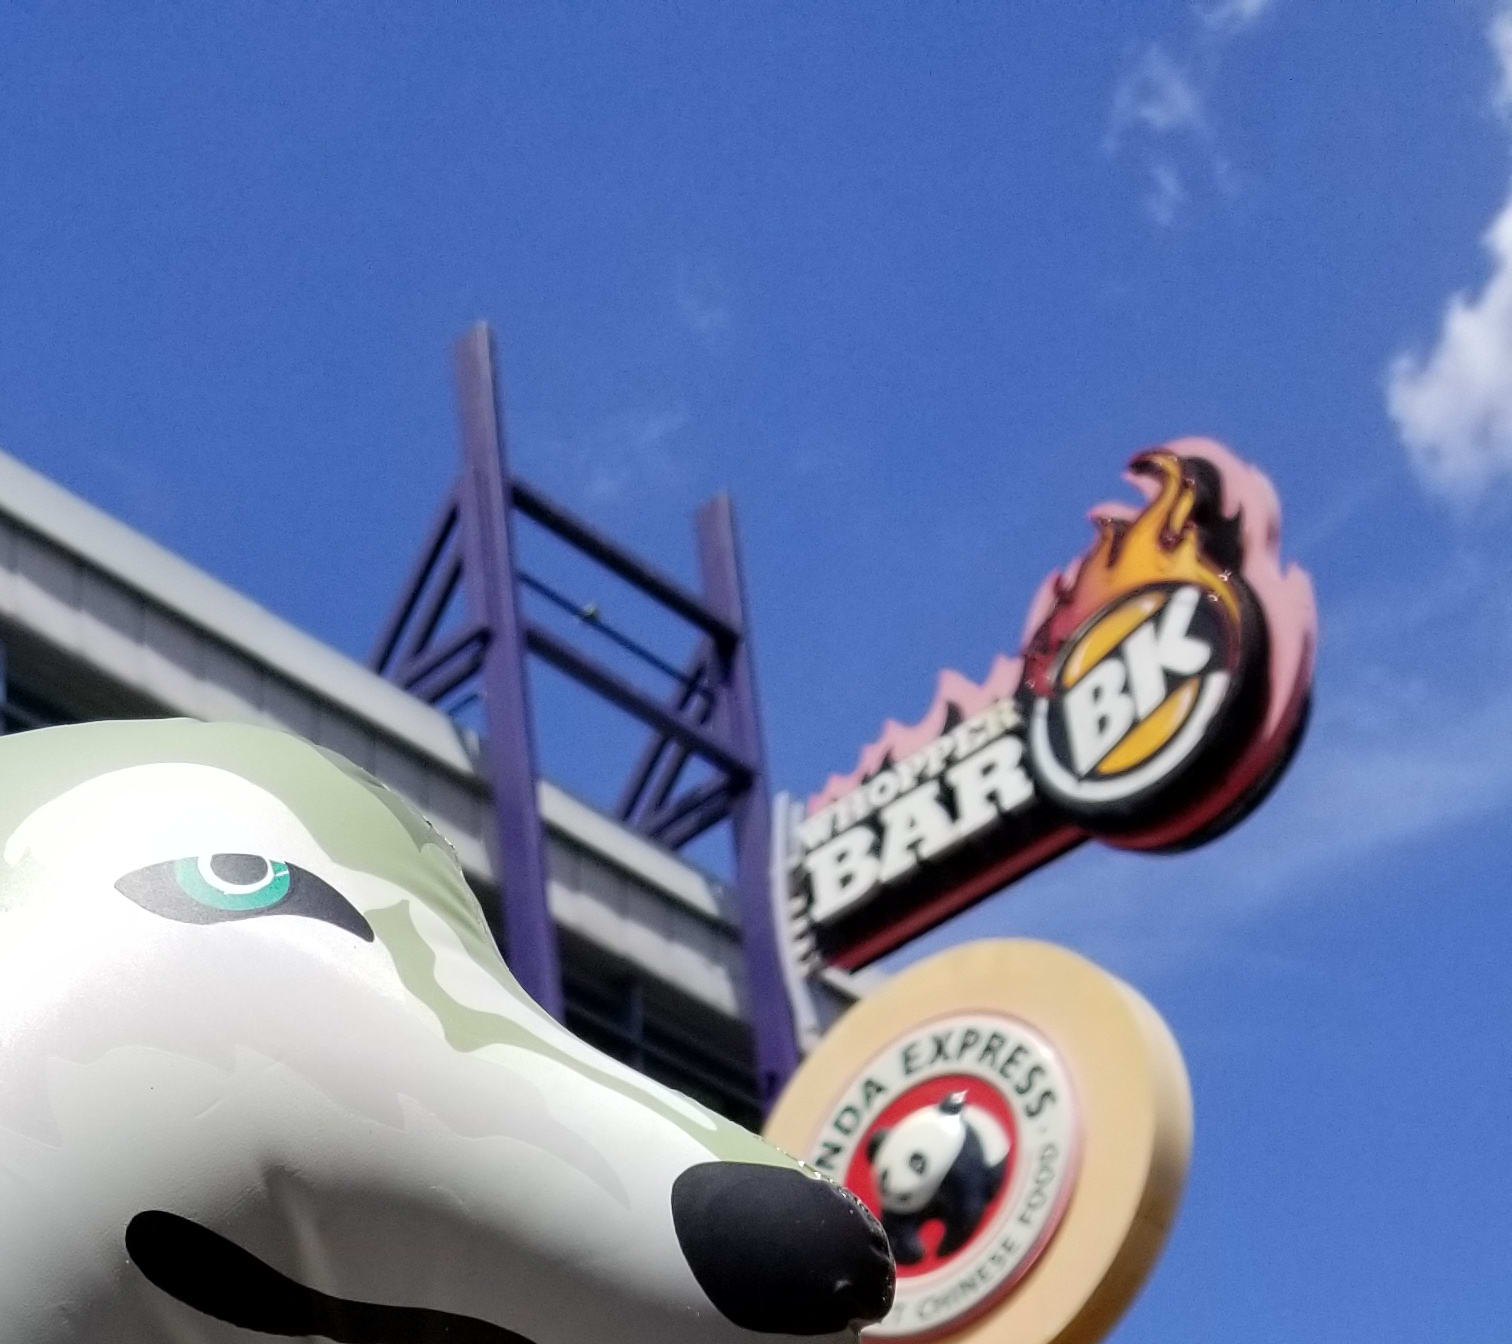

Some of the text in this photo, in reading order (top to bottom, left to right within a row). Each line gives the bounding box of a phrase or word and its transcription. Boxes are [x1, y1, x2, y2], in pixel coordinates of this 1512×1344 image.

[1064, 585, 1211, 779] BK
[798, 697, 1022, 848] WHOPPER
[805, 733, 1034, 922] BAR
[815, 1027, 1056, 1170] NDA EXPRESS
[1018, 1142, 1060, 1224] FOOD
